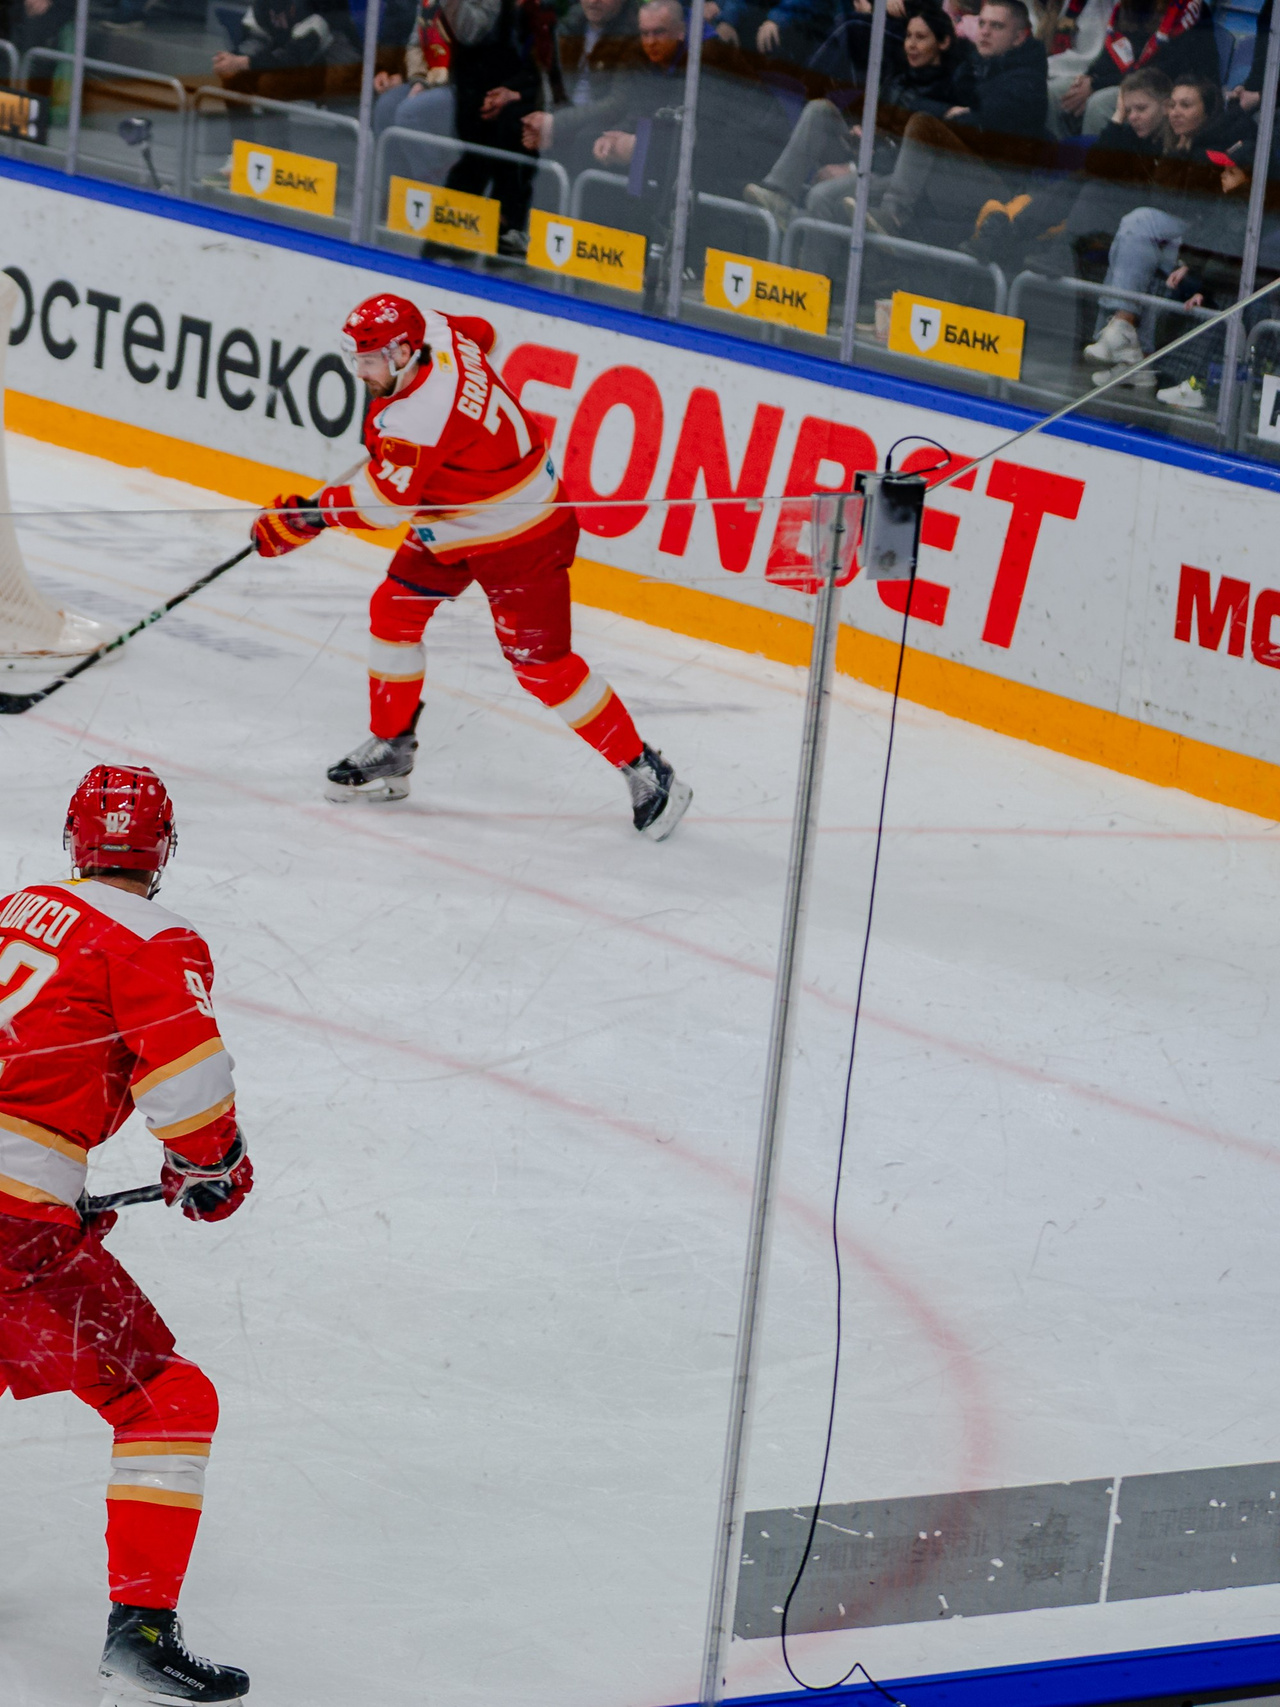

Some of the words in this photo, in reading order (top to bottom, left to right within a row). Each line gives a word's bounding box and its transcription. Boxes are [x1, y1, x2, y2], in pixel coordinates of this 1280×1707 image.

[274, 168, 318, 194] БАНК
[434, 205, 481, 232] БАНК
[575, 240, 624, 268] БАНК
[755, 281, 807, 310] БАНК
[944, 324, 1000, 354] БАНК
